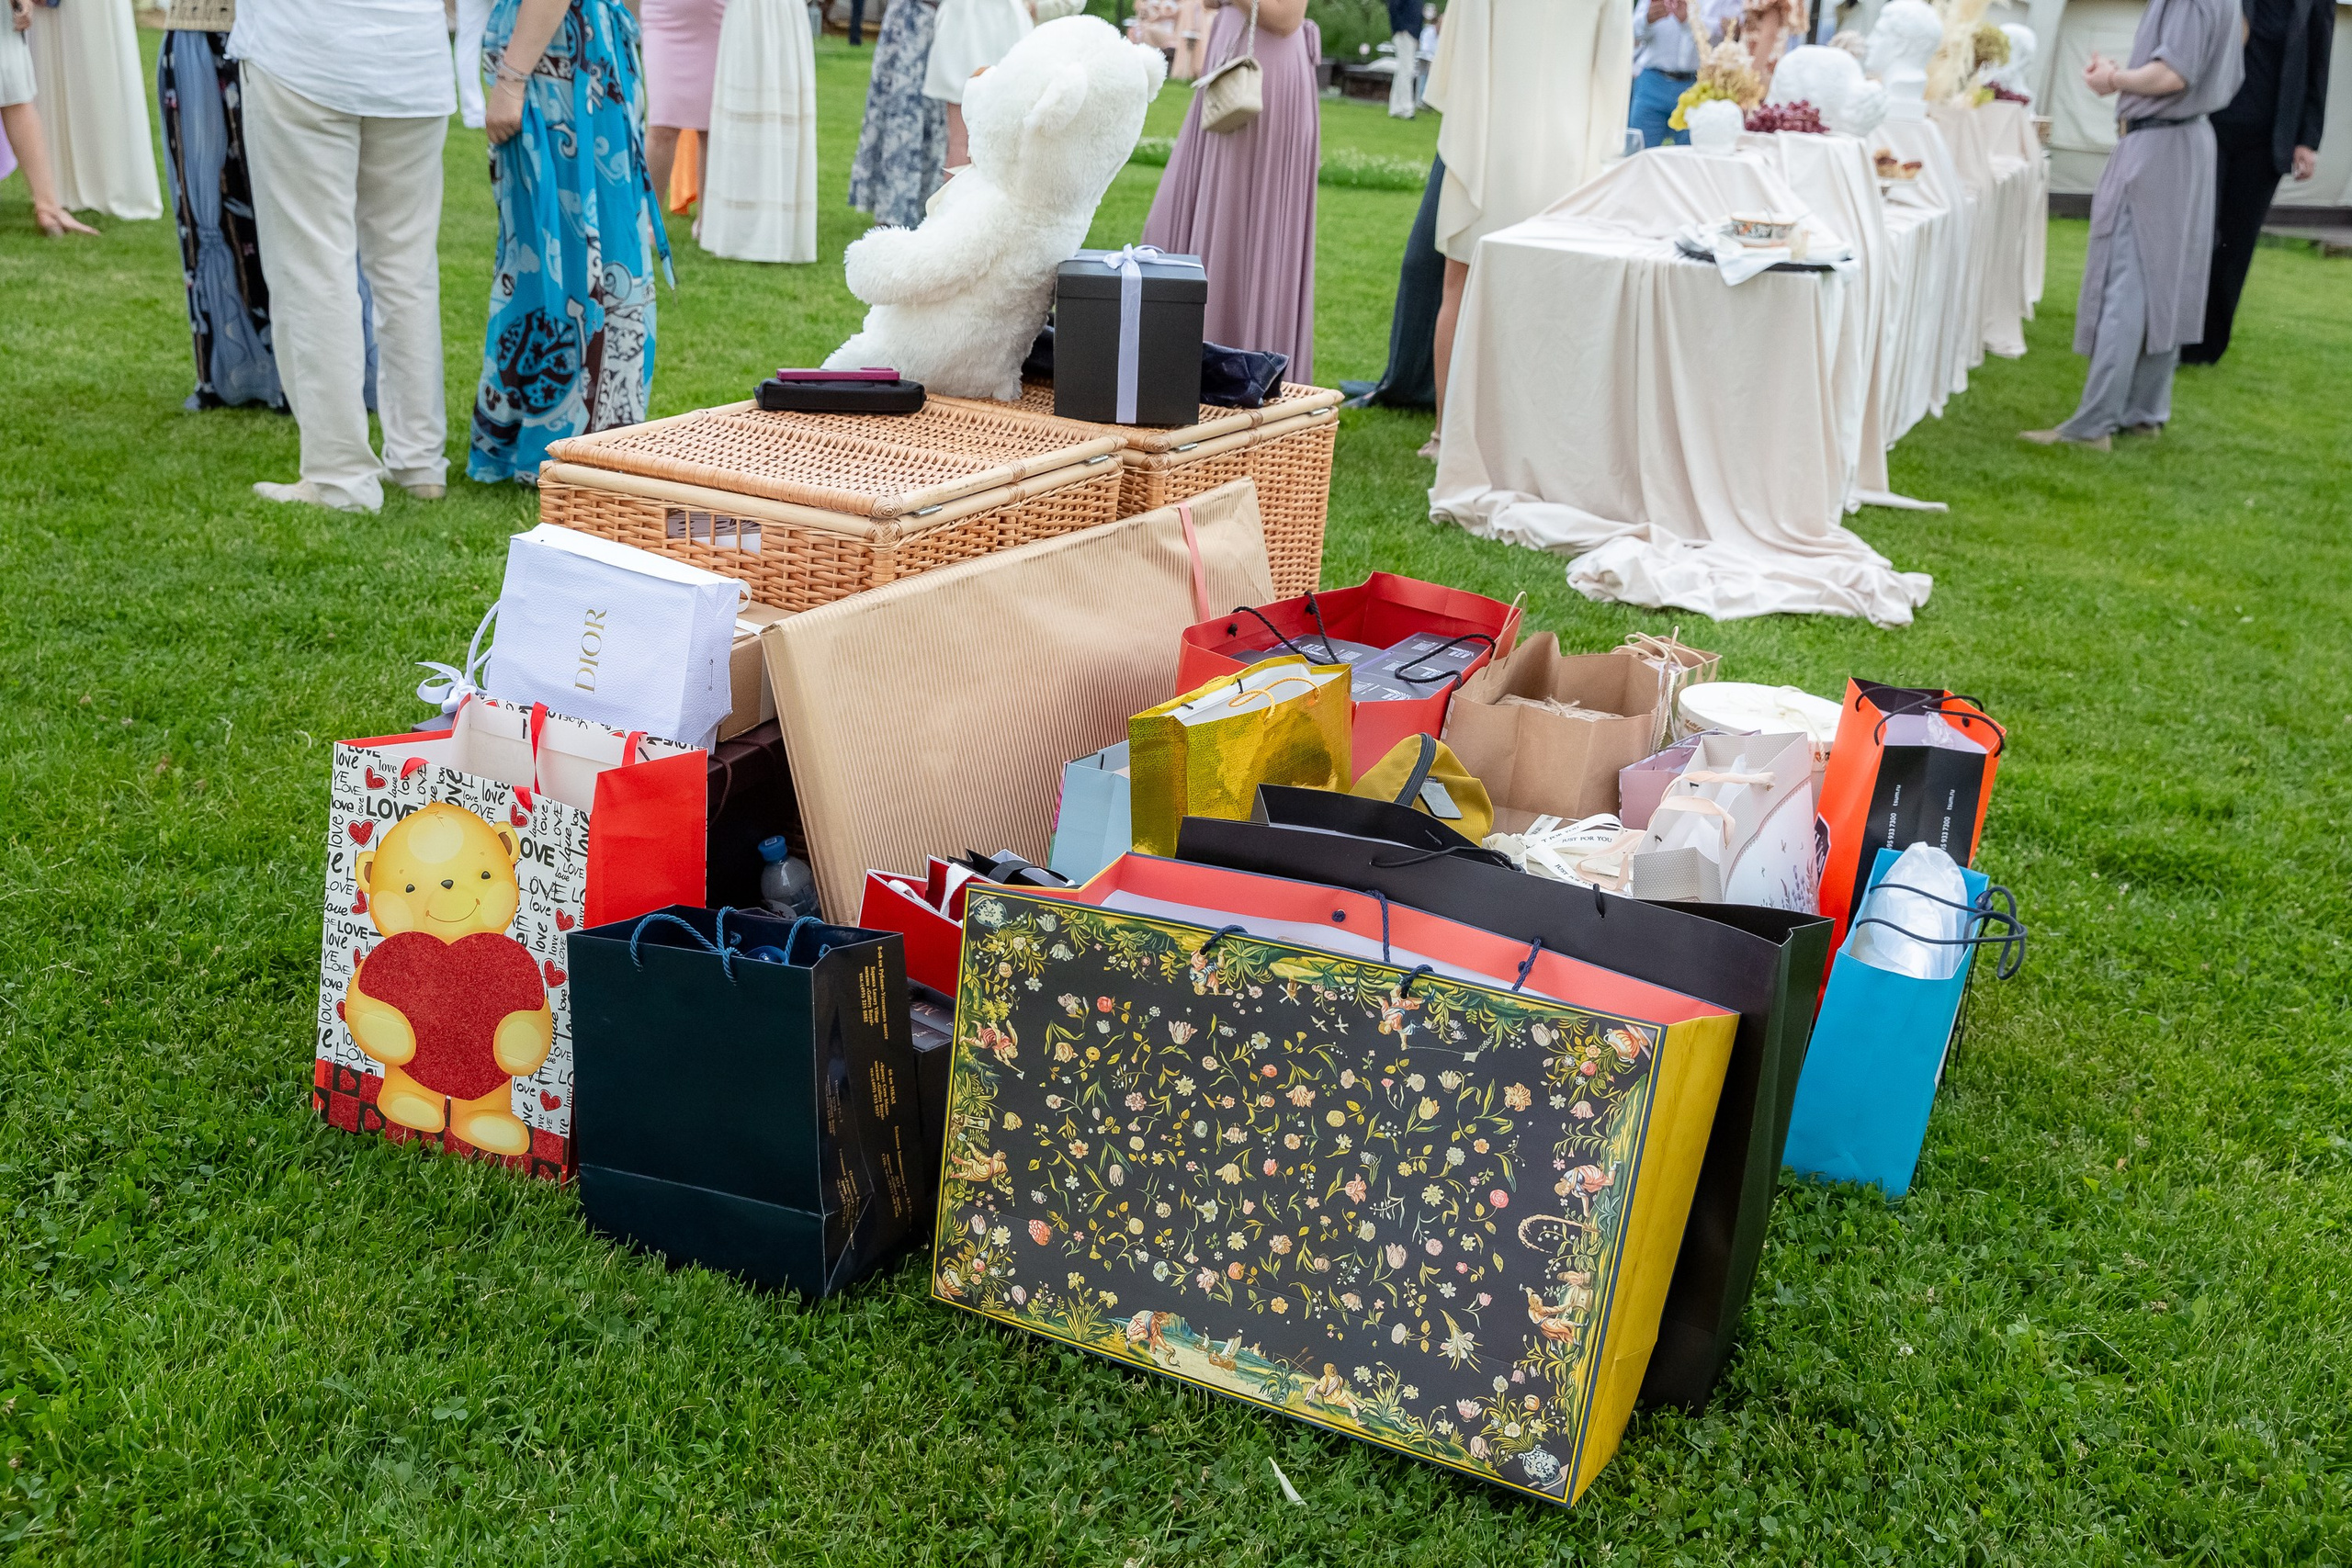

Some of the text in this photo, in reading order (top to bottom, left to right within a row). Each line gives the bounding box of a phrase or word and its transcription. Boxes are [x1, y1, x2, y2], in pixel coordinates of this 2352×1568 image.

[574, 608, 607, 694] DIOR
[335, 744, 359, 769] love
[379, 760, 398, 773] love
[334, 781, 364, 796] LOVE
[463, 790, 479, 802] love
[481, 779, 505, 806] love
[1893, 784, 1901, 807] tsum.ru
[331, 795, 355, 813] love
[356, 797, 365, 817] love
[1946, 789, 1955, 810] tsum.ru
[537, 805, 548, 836] love
[554, 800, 563, 848] LOVE
[1889, 812, 1897, 828] 7300
[1942, 816, 1951, 831] 7300
[328, 814, 345, 848] love
[1597, 835, 1613, 843] YOU
[1887, 828, 1895, 840] 933
[1940, 831, 1949, 843] 933
[520, 837, 555, 868] OVE
[555, 866, 571, 882] love
[562, 863, 585, 879] LOVE
[1555, 863, 1569, 876] JUST
[323, 895, 348, 917] love
[529, 896, 551, 917] love
[326, 923, 348, 949] love
[337, 920, 368, 940] LOVE
[529, 921, 548, 953] love
[548, 934, 559, 956] love
[558, 937, 567, 965] LOVE
[324, 960, 353, 976] LOVE
[321, 973, 344, 993] love
[318, 992, 333, 1025] love
[558, 988, 568, 1011] love
[335, 1042, 379, 1068] LOVE
[513, 1077, 537, 1098] love
[563, 1088, 573, 1109] love
[522, 1101, 534, 1127] ove
